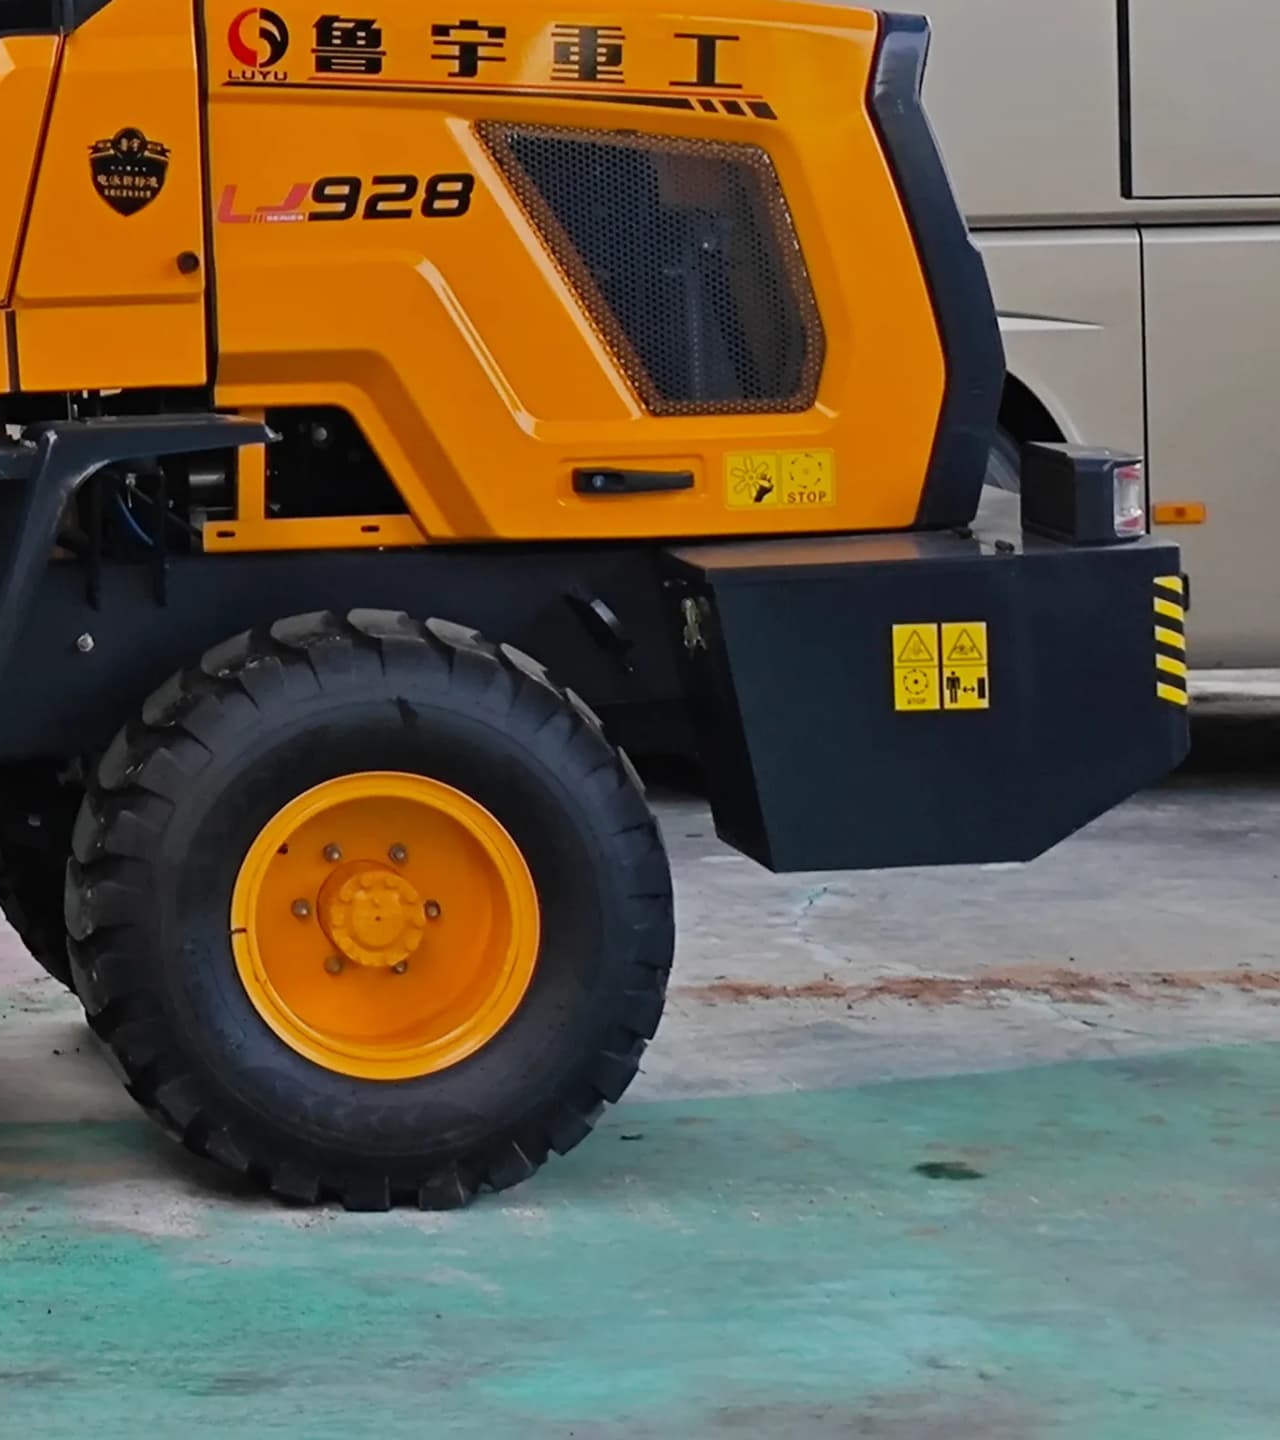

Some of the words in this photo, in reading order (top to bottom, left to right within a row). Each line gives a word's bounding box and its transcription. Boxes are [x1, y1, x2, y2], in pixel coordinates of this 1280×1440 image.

[311, 14, 743, 90] 鲁宇重工
[228, 69, 288, 81] LUYU
[786, 490, 827, 504] STOP
